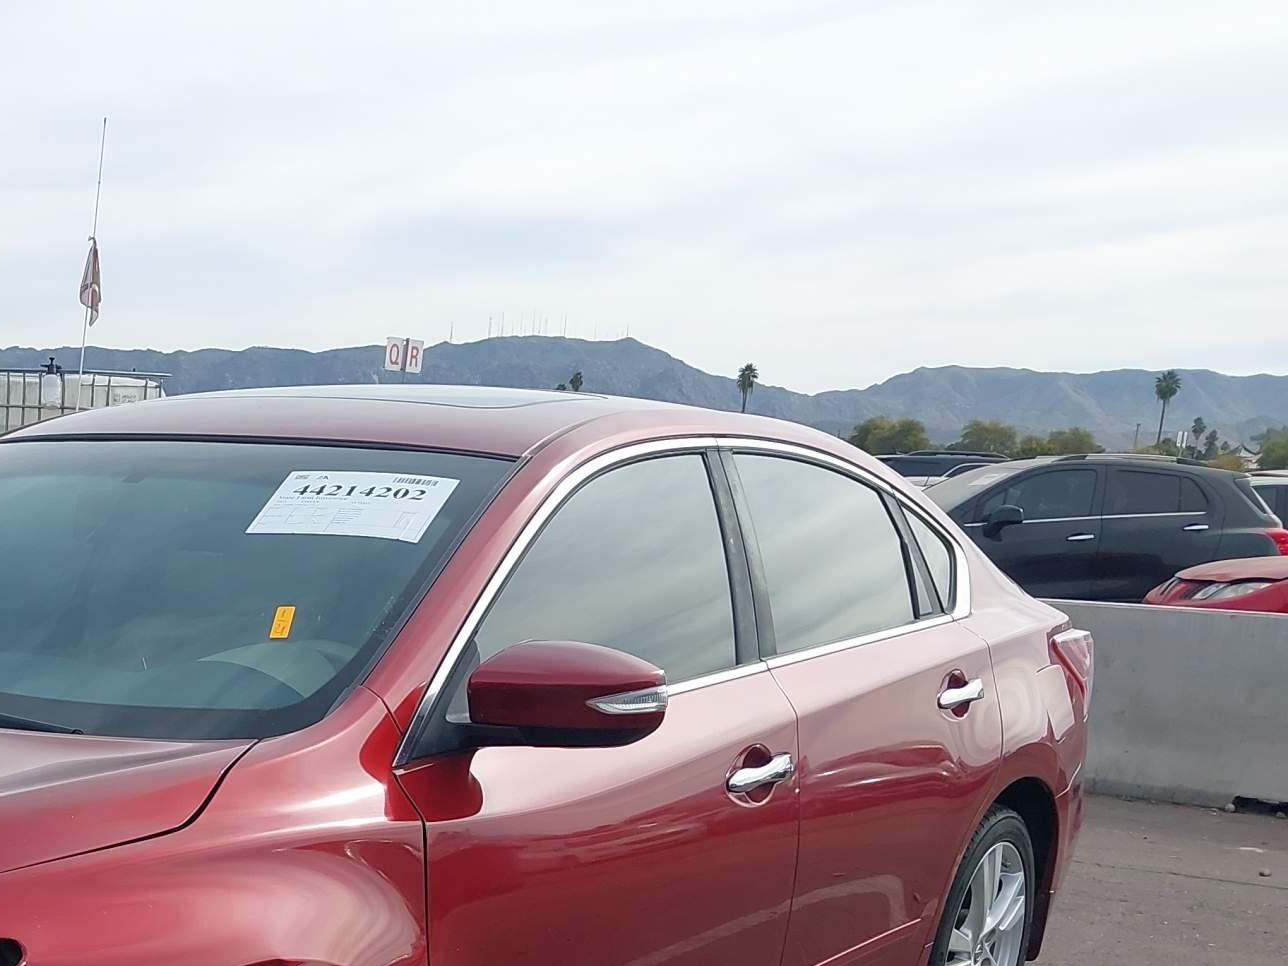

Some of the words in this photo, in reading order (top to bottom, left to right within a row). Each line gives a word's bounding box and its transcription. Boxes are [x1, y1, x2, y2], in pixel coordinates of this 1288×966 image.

[390, 344, 400, 366] Q
[409, 346, 420, 368] R
[293, 484, 427, 500] 44214202
